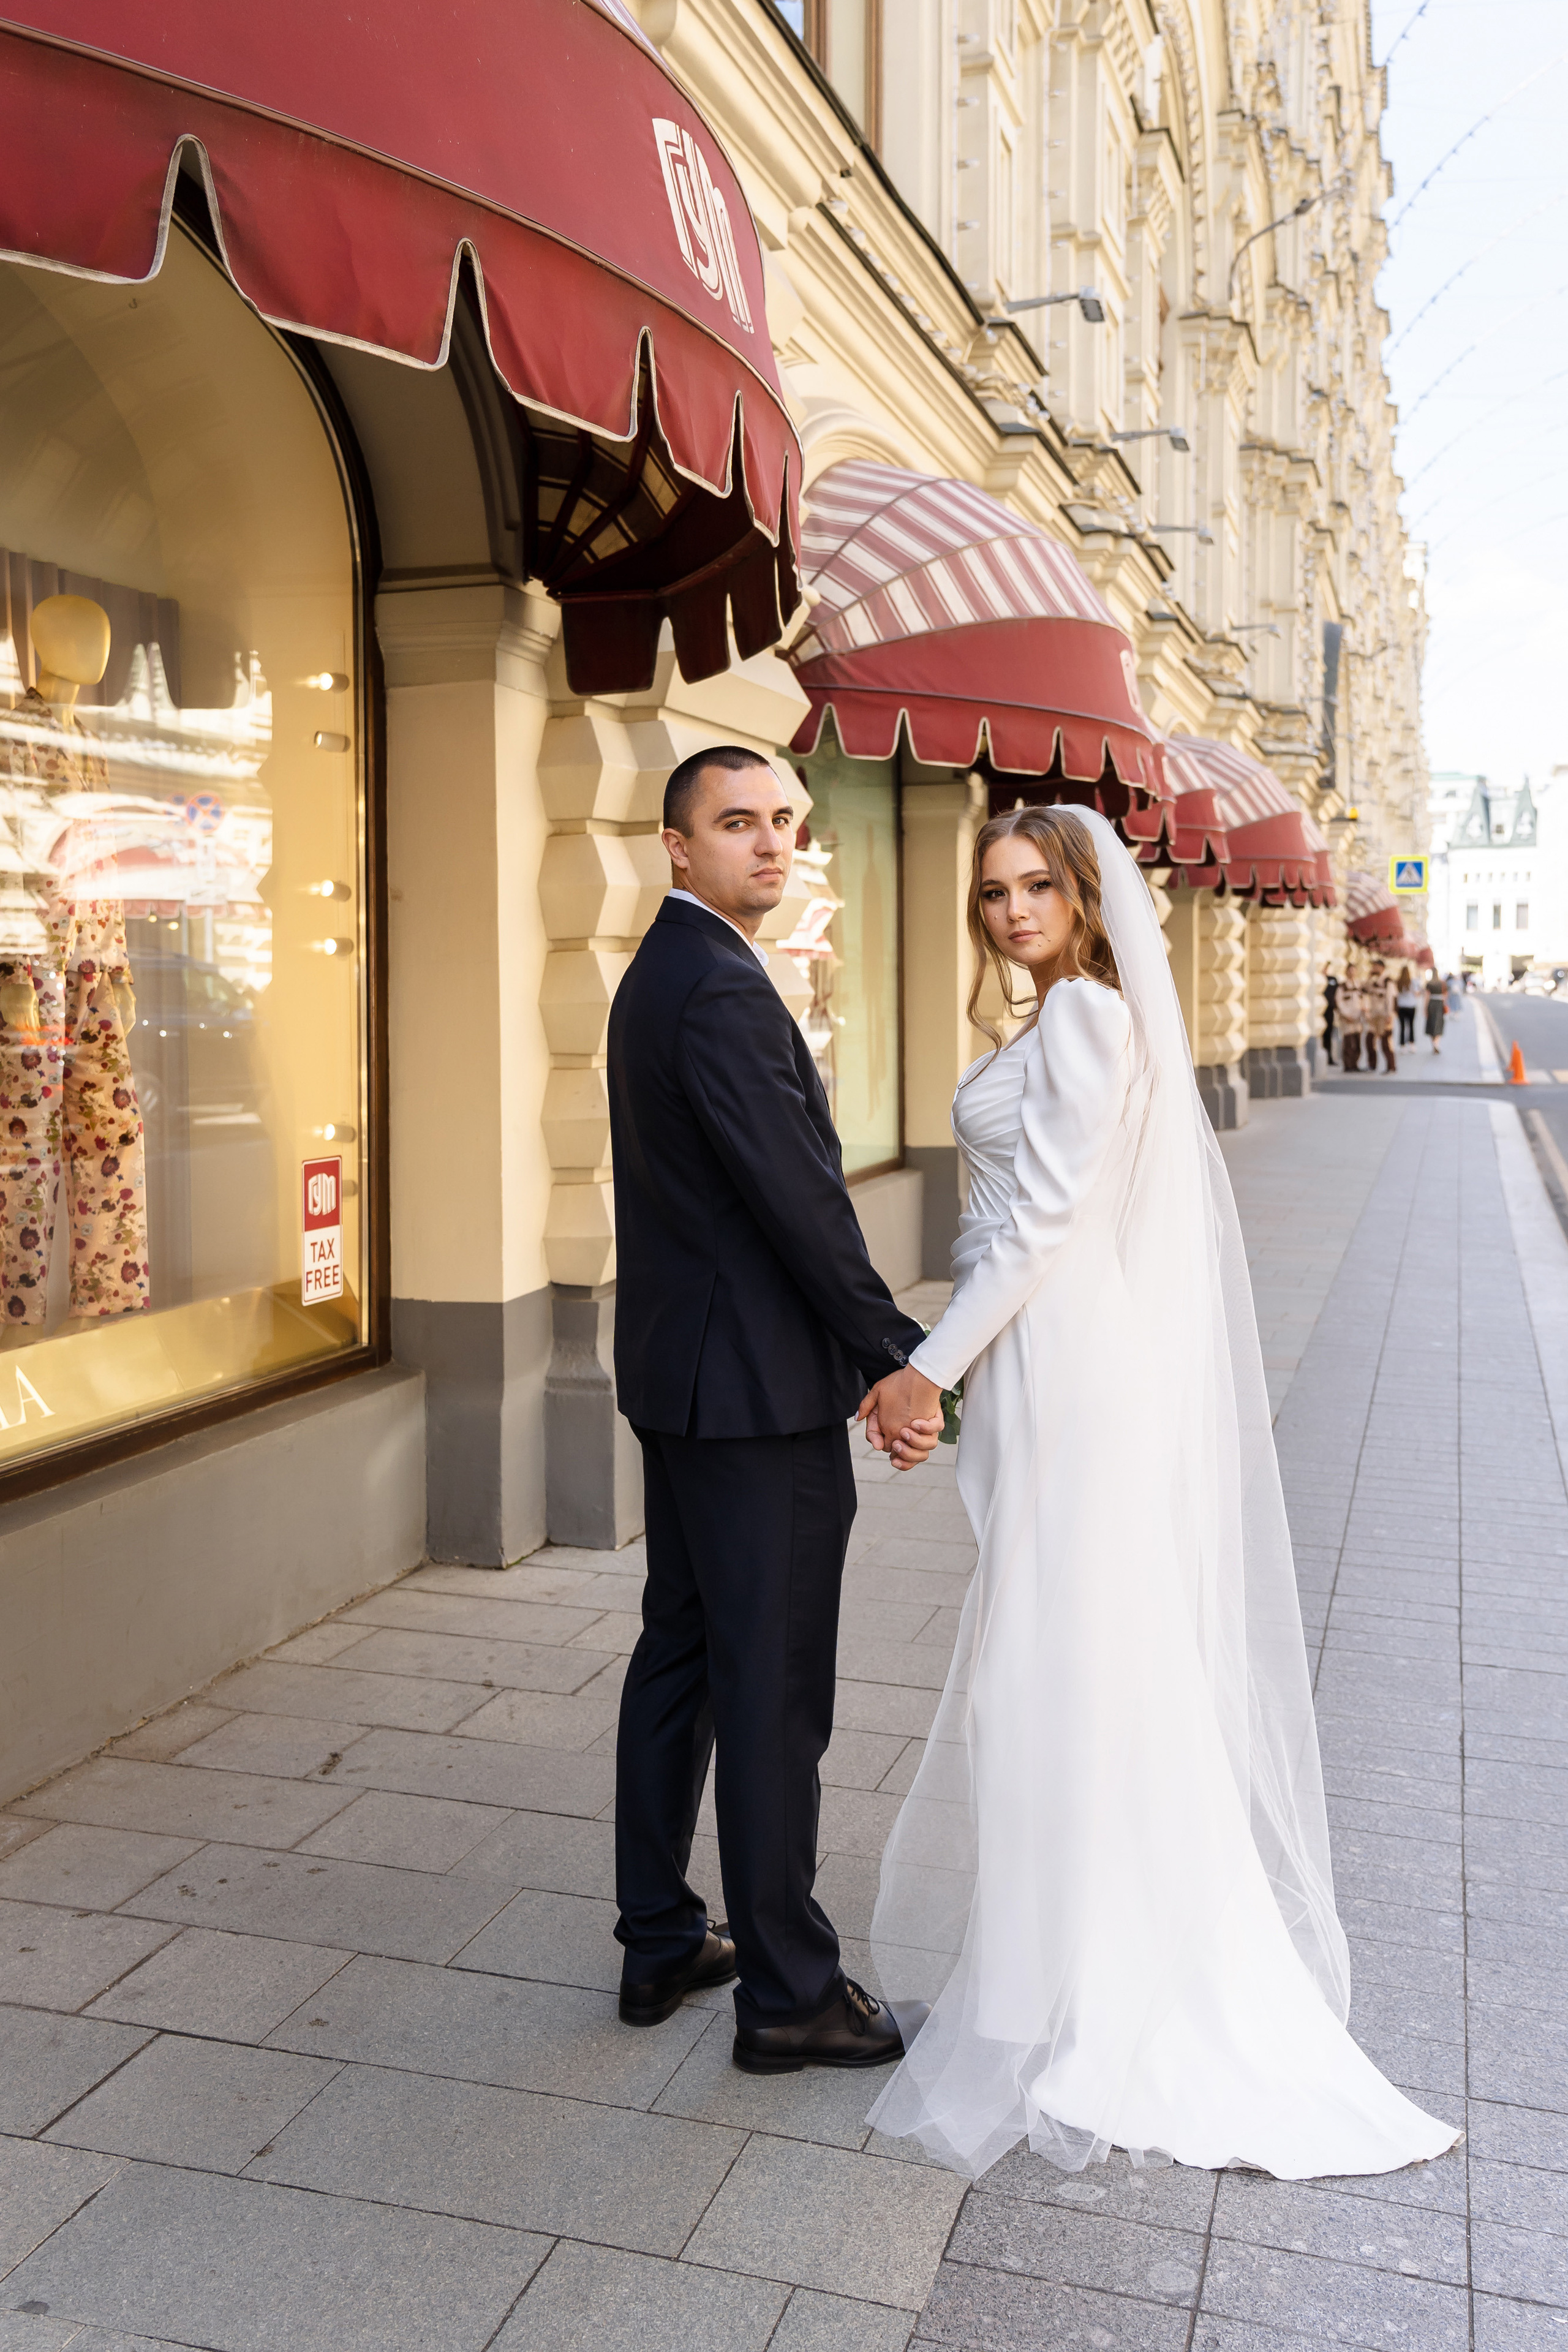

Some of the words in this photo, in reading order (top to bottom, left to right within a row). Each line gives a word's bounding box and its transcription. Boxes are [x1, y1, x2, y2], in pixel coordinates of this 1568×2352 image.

[310, 1238, 335, 1263] TAX
[306, 1264, 340, 1292] FREE
[0, 1365, 56, 1430] A
